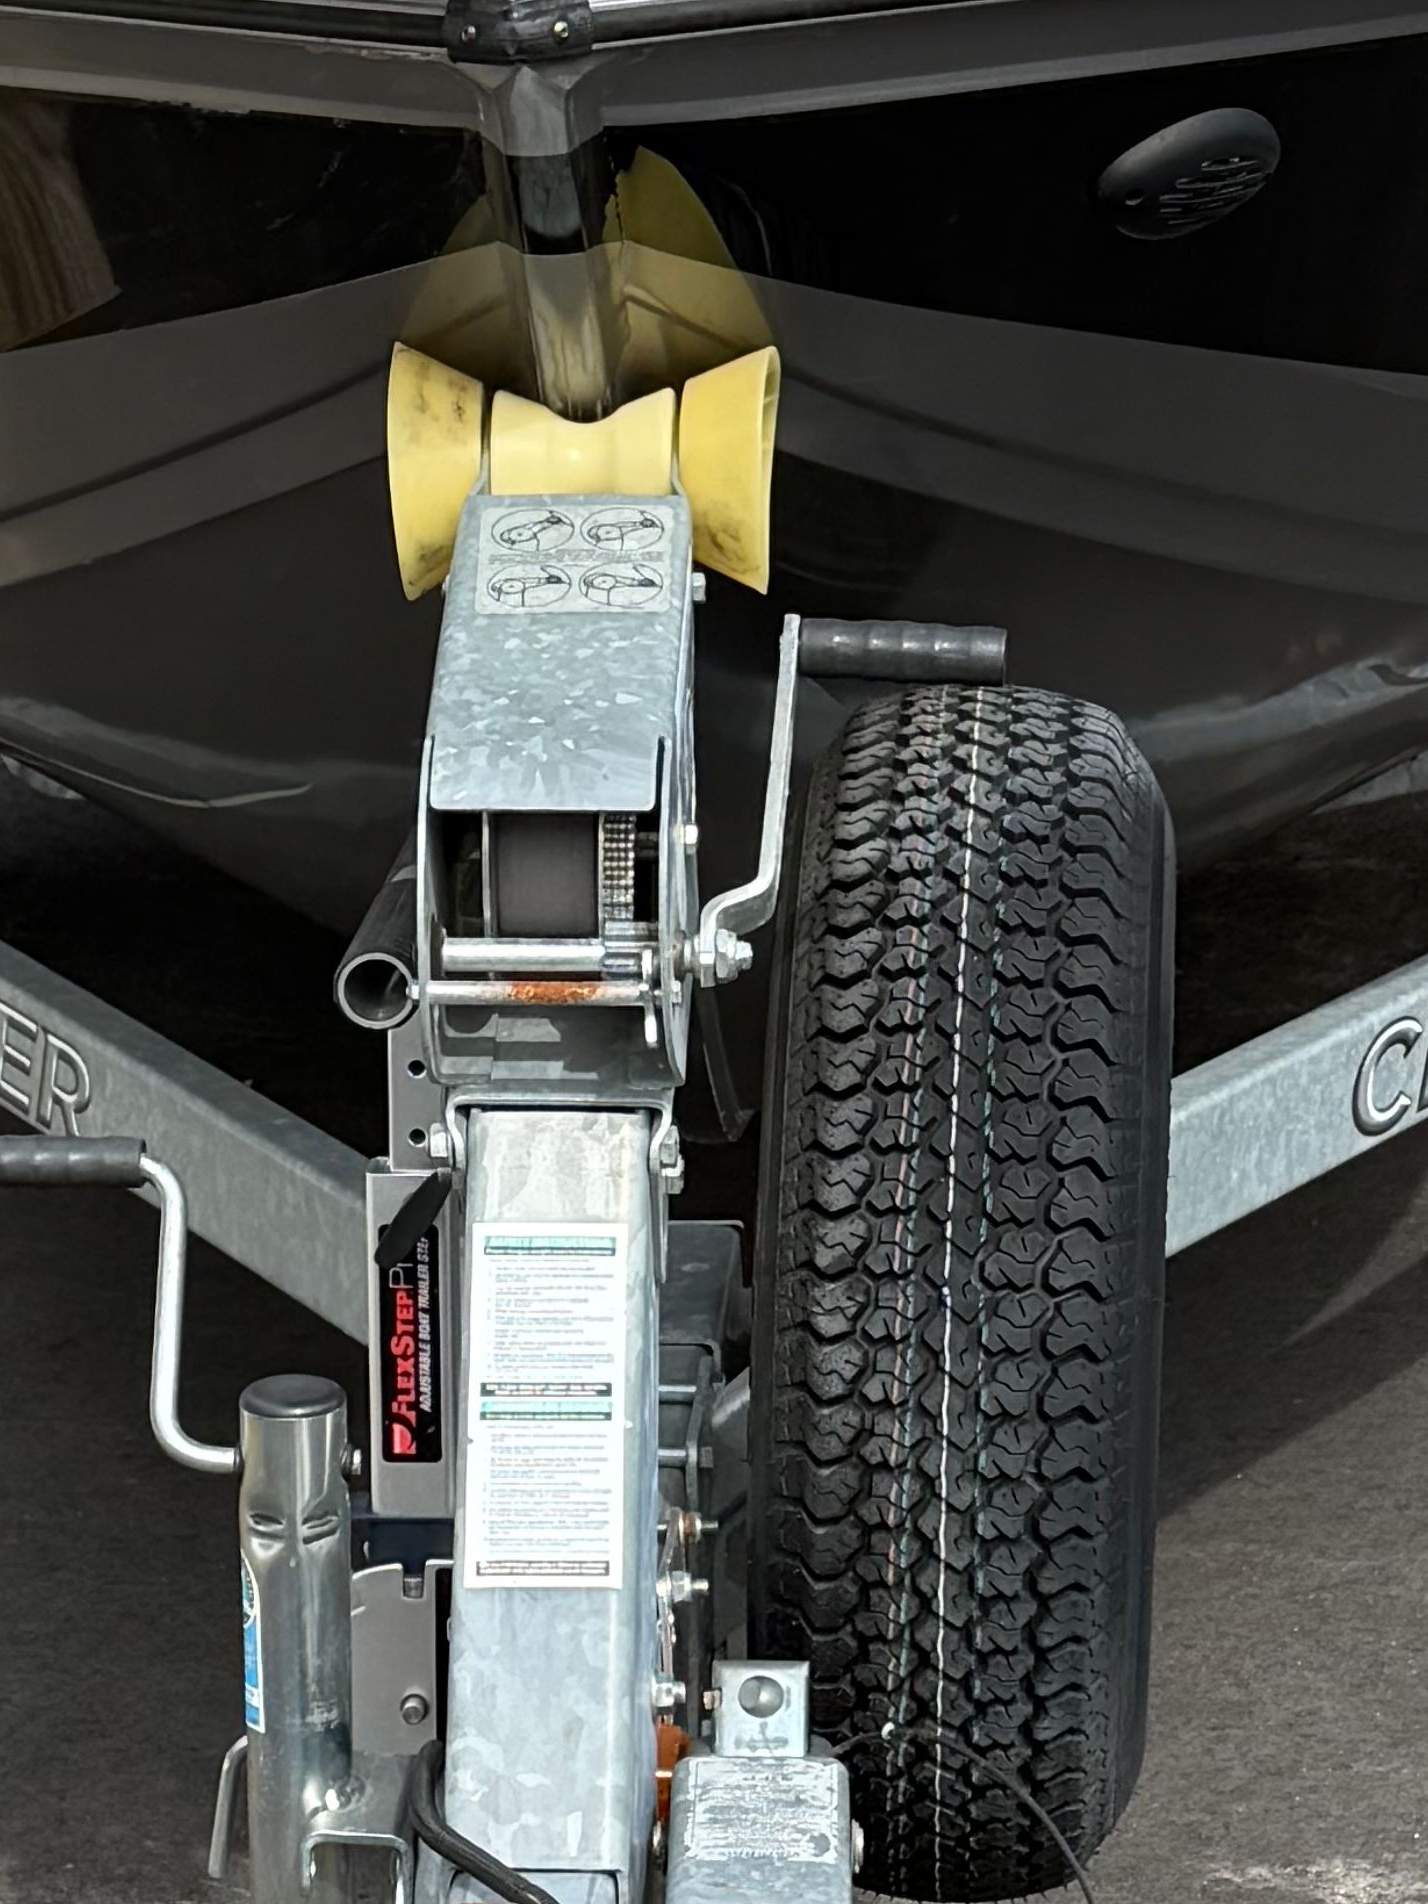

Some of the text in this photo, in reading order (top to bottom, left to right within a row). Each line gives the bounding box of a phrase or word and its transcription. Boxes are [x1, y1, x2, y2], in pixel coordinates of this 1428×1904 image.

[417, 1264, 430, 1310] TRAILER
[418, 1311, 431, 1341] BOAT
[418, 1342, 432, 1413] ADJUSTABLE
